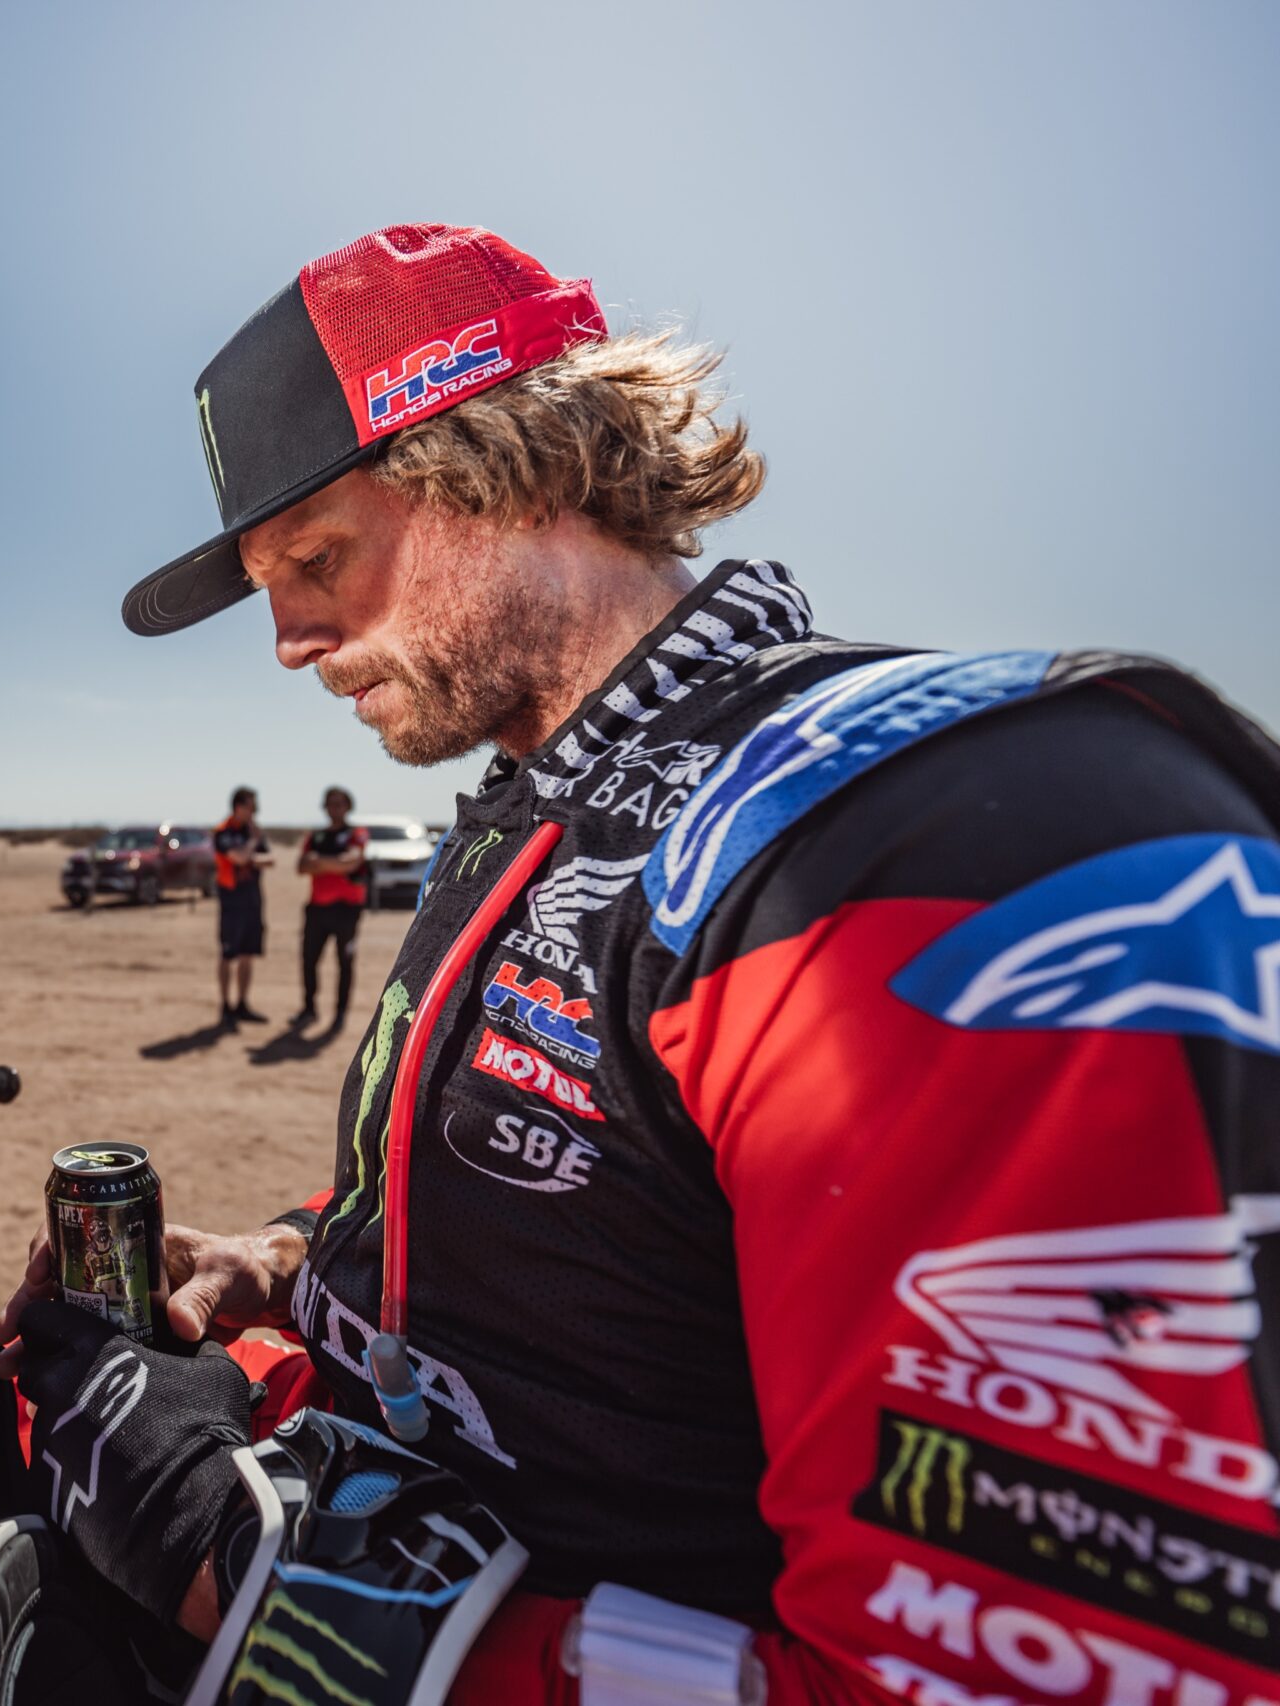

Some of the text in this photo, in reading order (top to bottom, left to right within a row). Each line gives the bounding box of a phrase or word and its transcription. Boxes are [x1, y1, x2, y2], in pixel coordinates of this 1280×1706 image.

[367, 318, 502, 422] HRC
[371, 357, 513, 432] Honda RACING
[480, 1038, 596, 1113] MOTUL
[487, 1114, 603, 1186] SBE
[58, 1205, 85, 1224] APEX
[881, 1344, 1280, 1506] HOND
